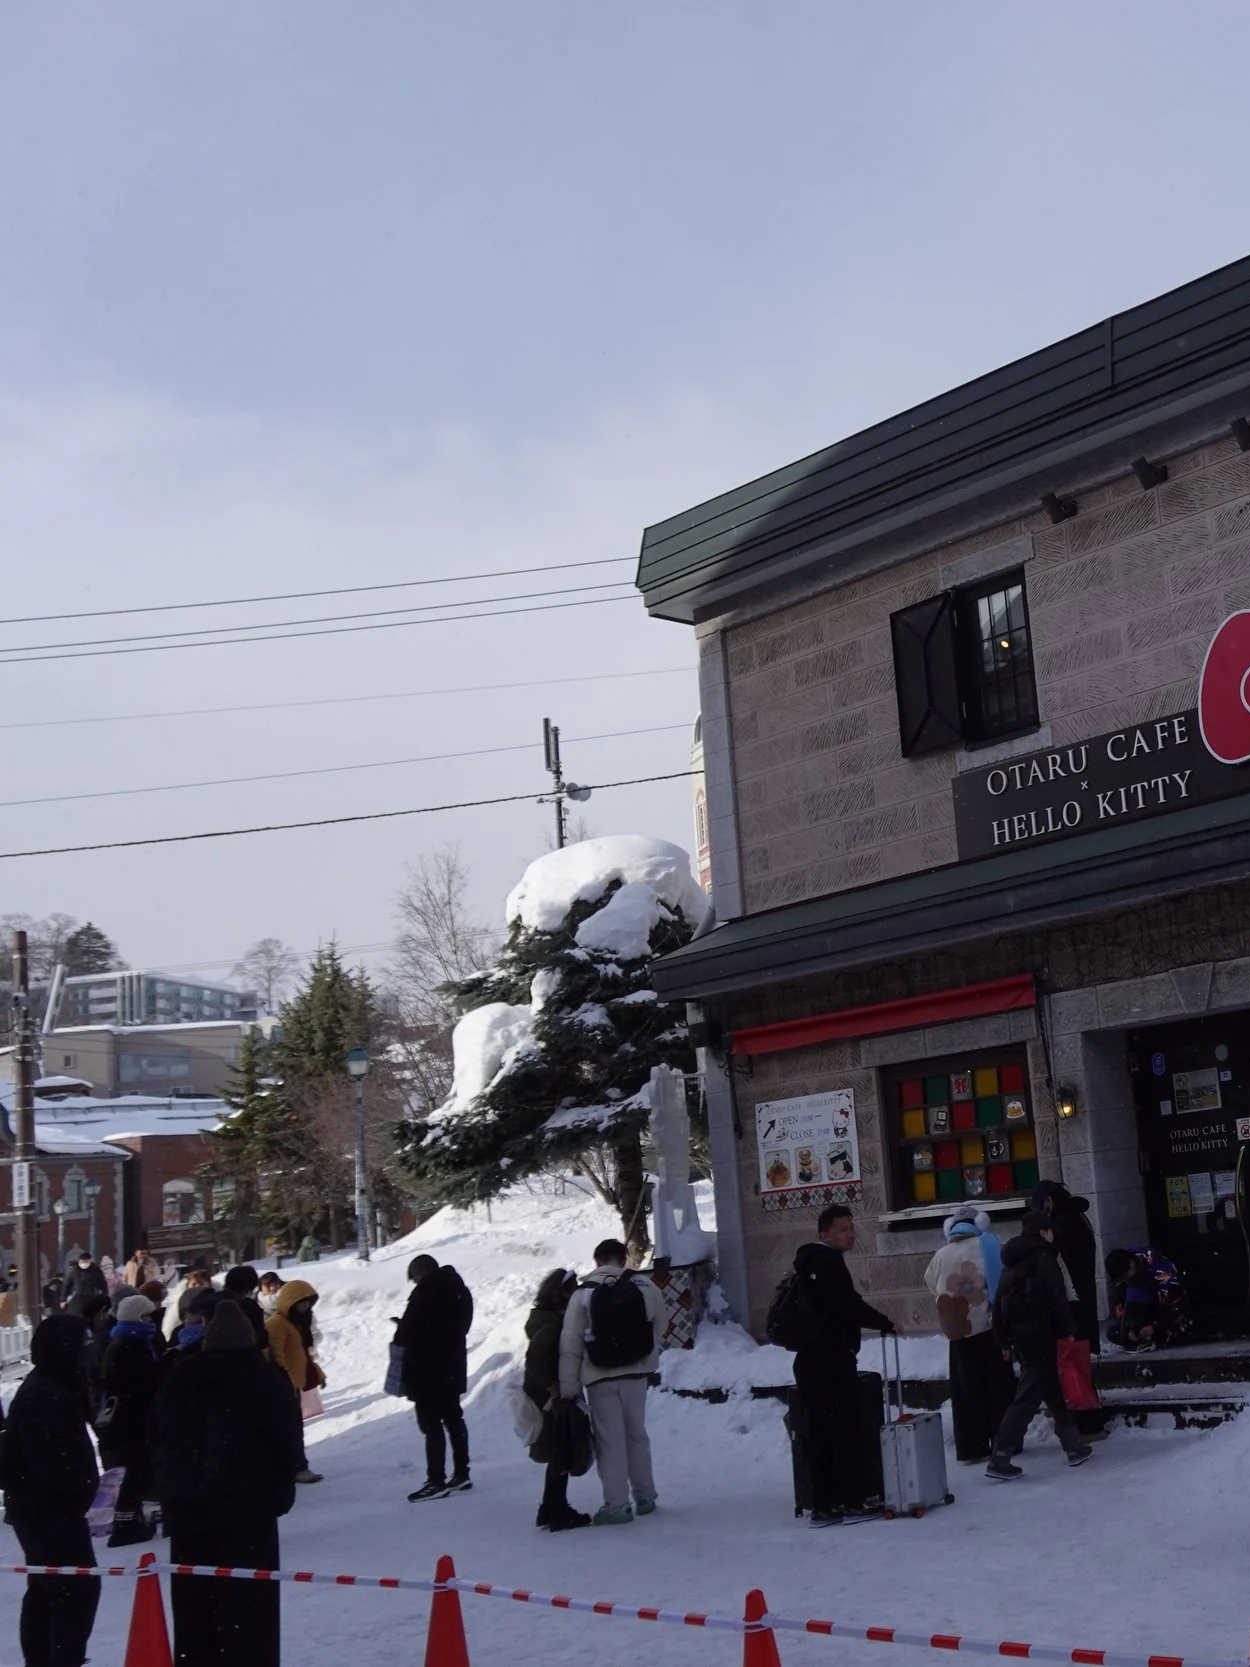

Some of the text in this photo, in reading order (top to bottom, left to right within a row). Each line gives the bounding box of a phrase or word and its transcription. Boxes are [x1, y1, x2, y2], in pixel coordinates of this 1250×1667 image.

[986, 716, 1190, 796] OTARU CAFE
[992, 769, 1193, 846] HELLO KITTY
[778, 1115, 799, 1127] OPEN
[790, 1128, 814, 1141] CLOSE
[1169, 1122, 1227, 1140] OTARU CAFE
[1171, 1138, 1228, 1154] HELLO KITTY
